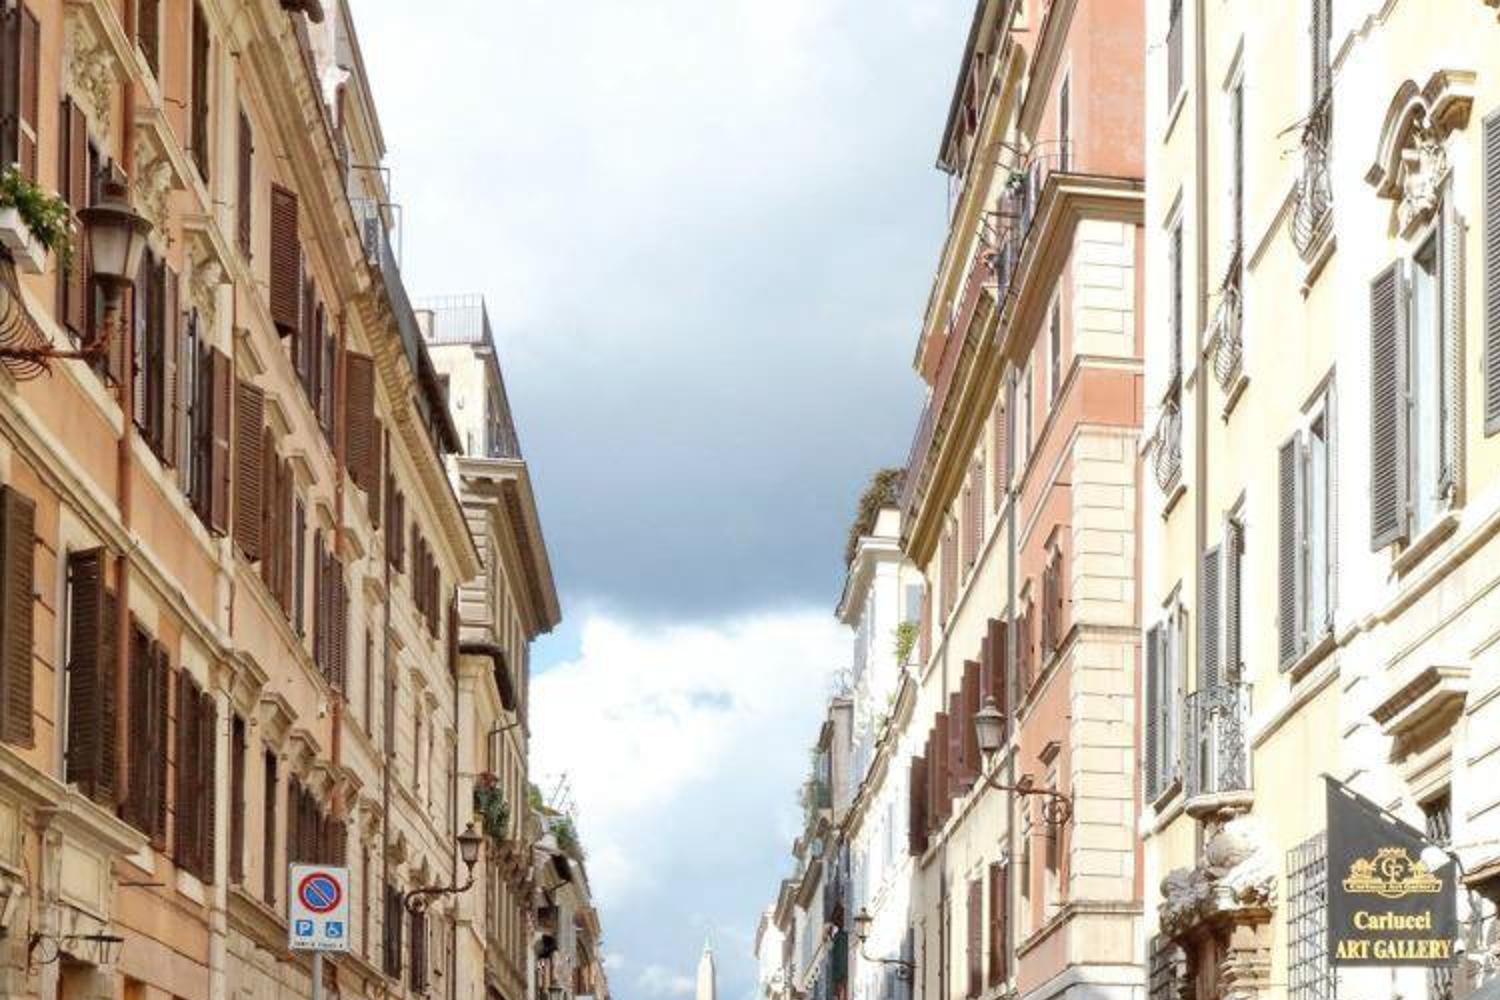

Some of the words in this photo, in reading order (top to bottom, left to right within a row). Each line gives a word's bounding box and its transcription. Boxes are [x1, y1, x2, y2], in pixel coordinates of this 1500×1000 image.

[1353, 911, 1431, 929] Carlucci
[1335, 940, 1370, 959] ART
[1373, 940, 1451, 959] GALLERY
